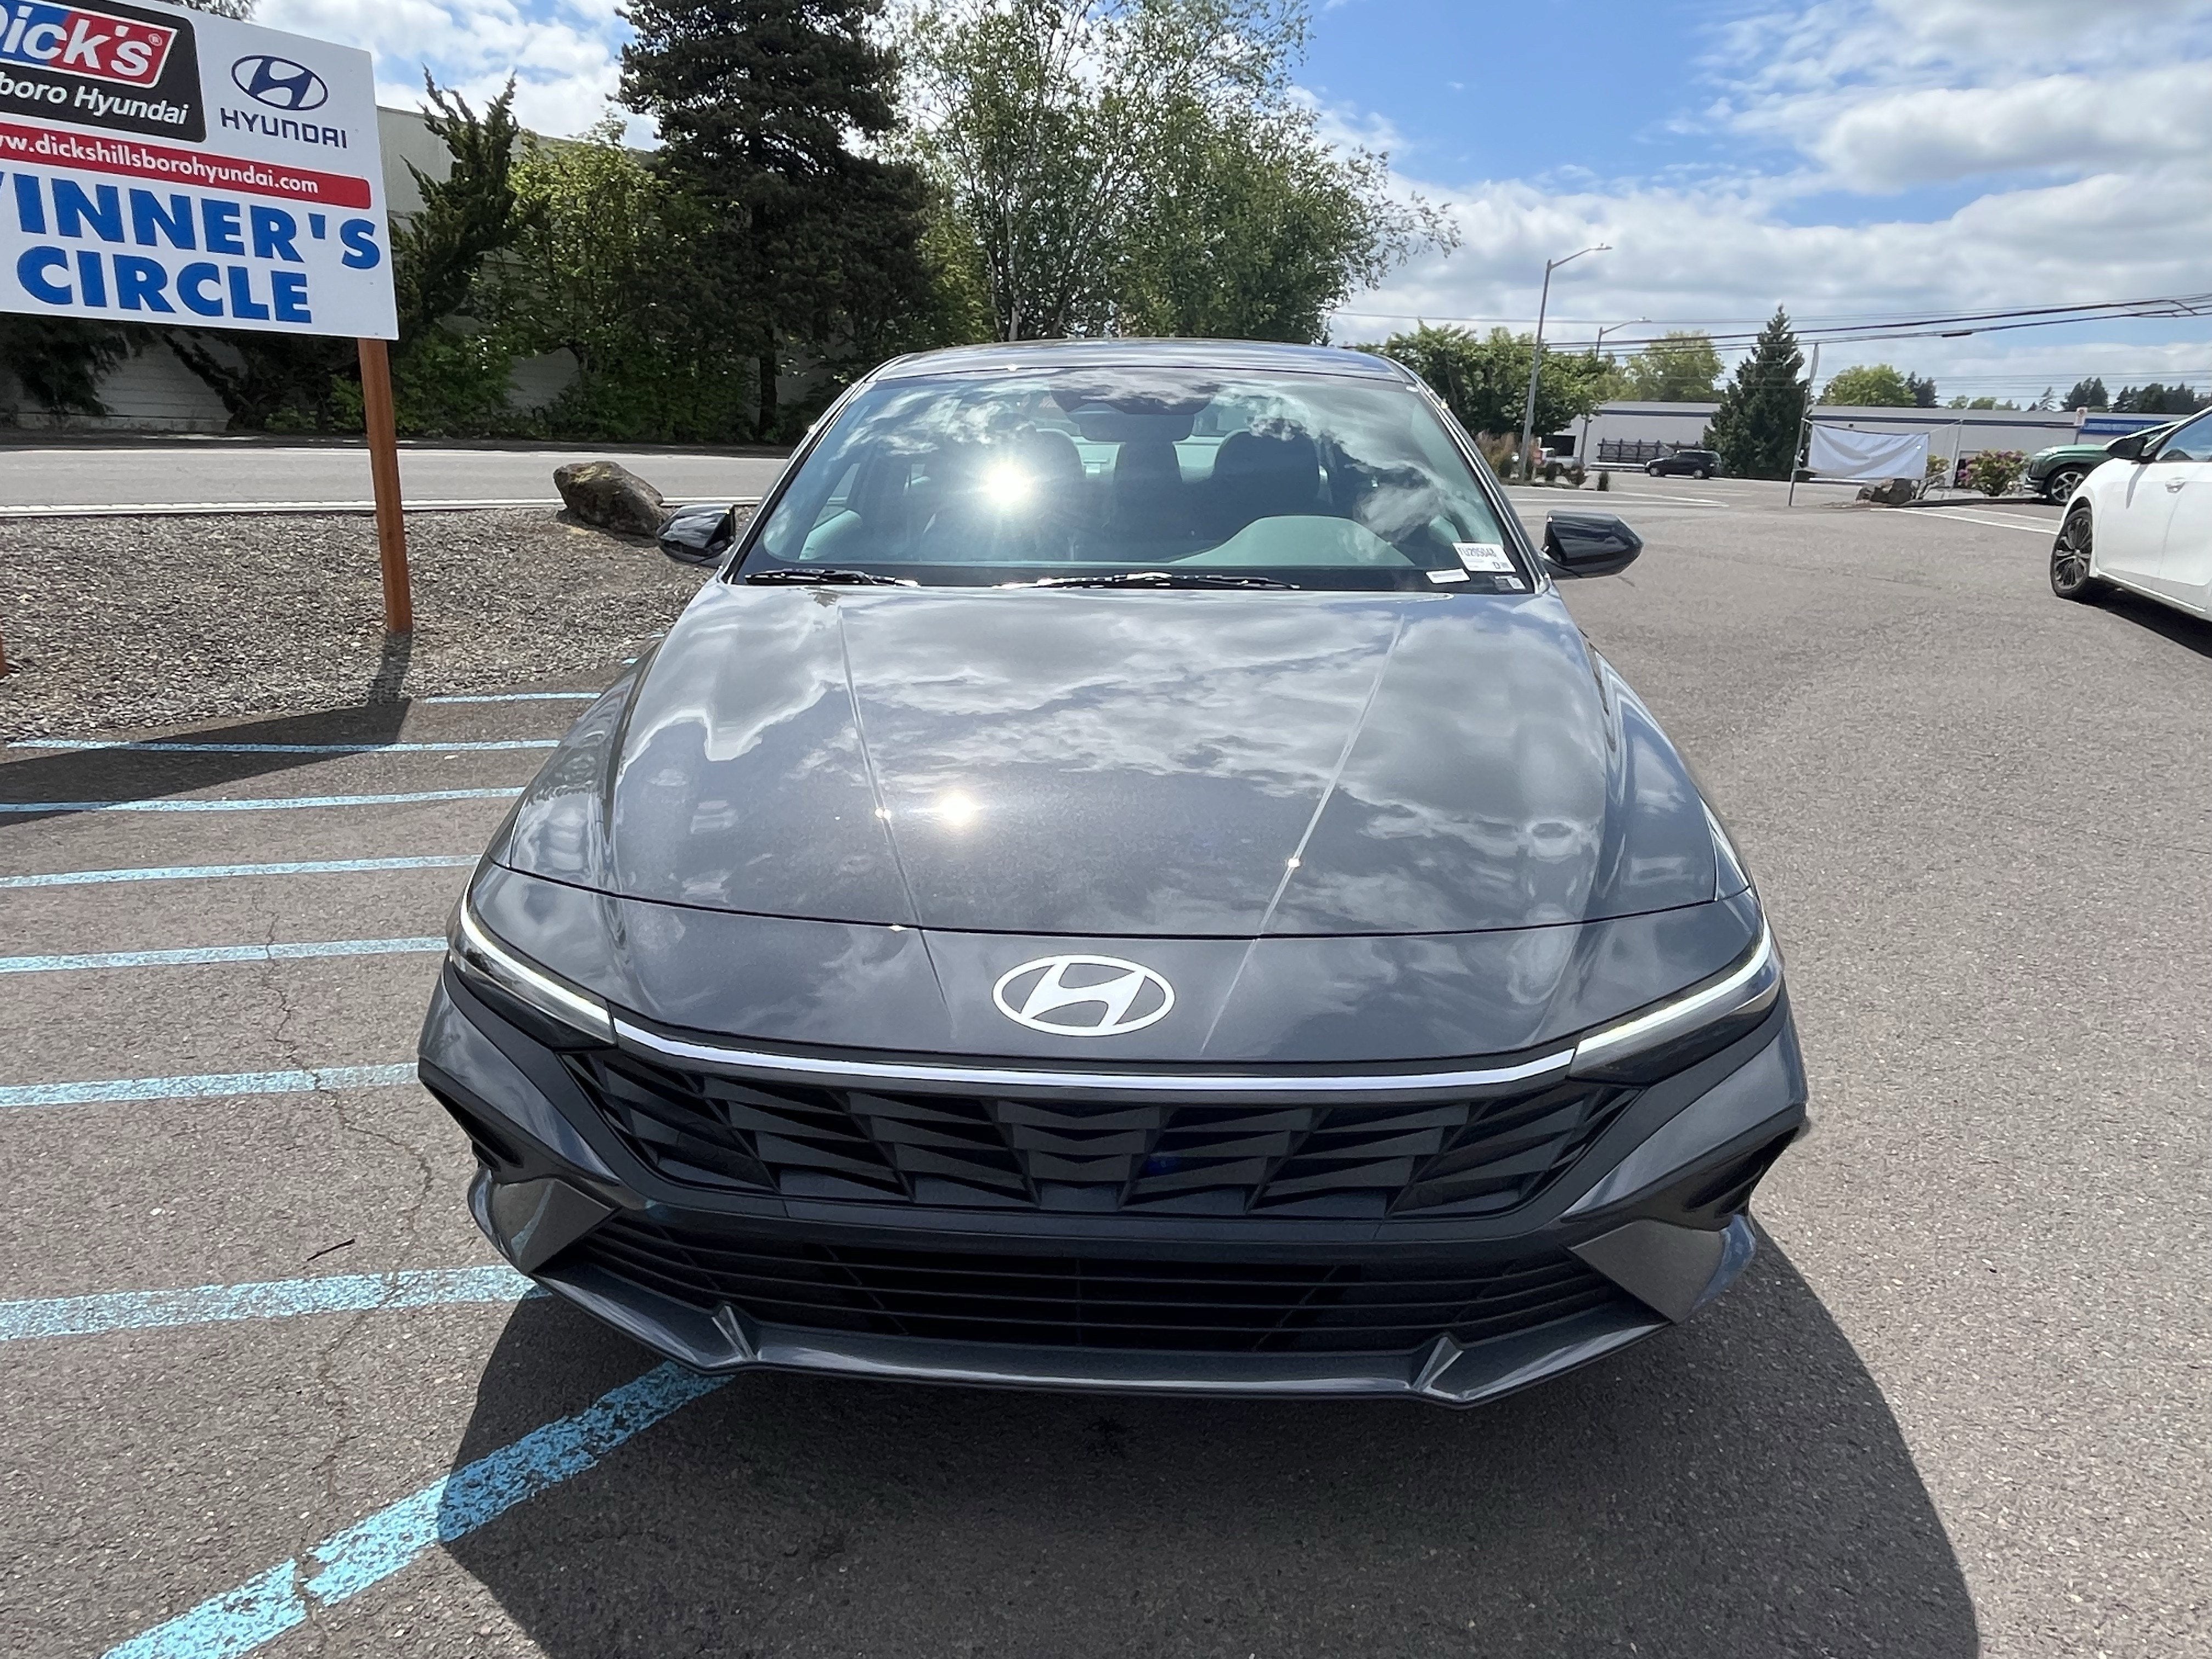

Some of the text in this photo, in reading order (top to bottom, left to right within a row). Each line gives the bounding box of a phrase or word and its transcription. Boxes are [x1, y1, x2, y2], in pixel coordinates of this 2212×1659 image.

[0, 3, 153, 77] ick's
[74, 86, 189, 125] Hyundai
[220, 108, 348, 149] HYUNDAI
[0, 133, 319, 194] w.dickshillsborohyundai.com
[0, 171, 381, 269] INNER'S
[16, 246, 312, 324] CIRCLE
